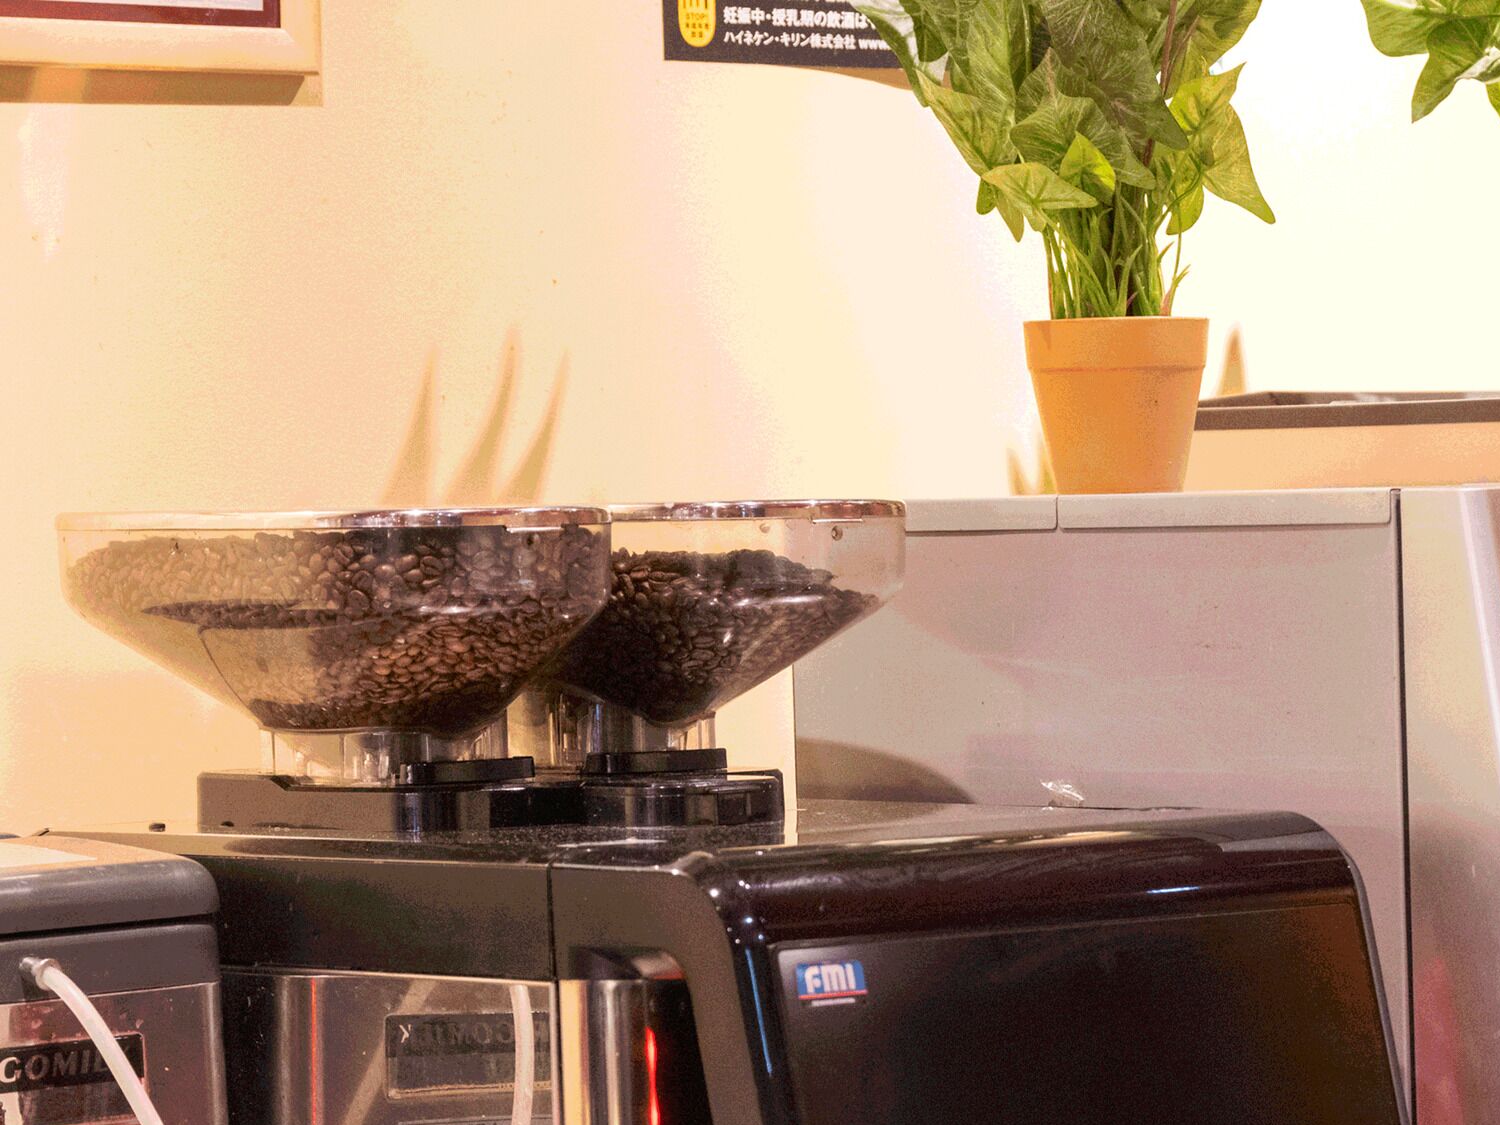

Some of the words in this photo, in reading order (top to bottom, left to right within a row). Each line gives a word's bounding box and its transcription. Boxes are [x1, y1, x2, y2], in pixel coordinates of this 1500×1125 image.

[723, 30, 856, 50] ハイネケン・キリン株式会社
